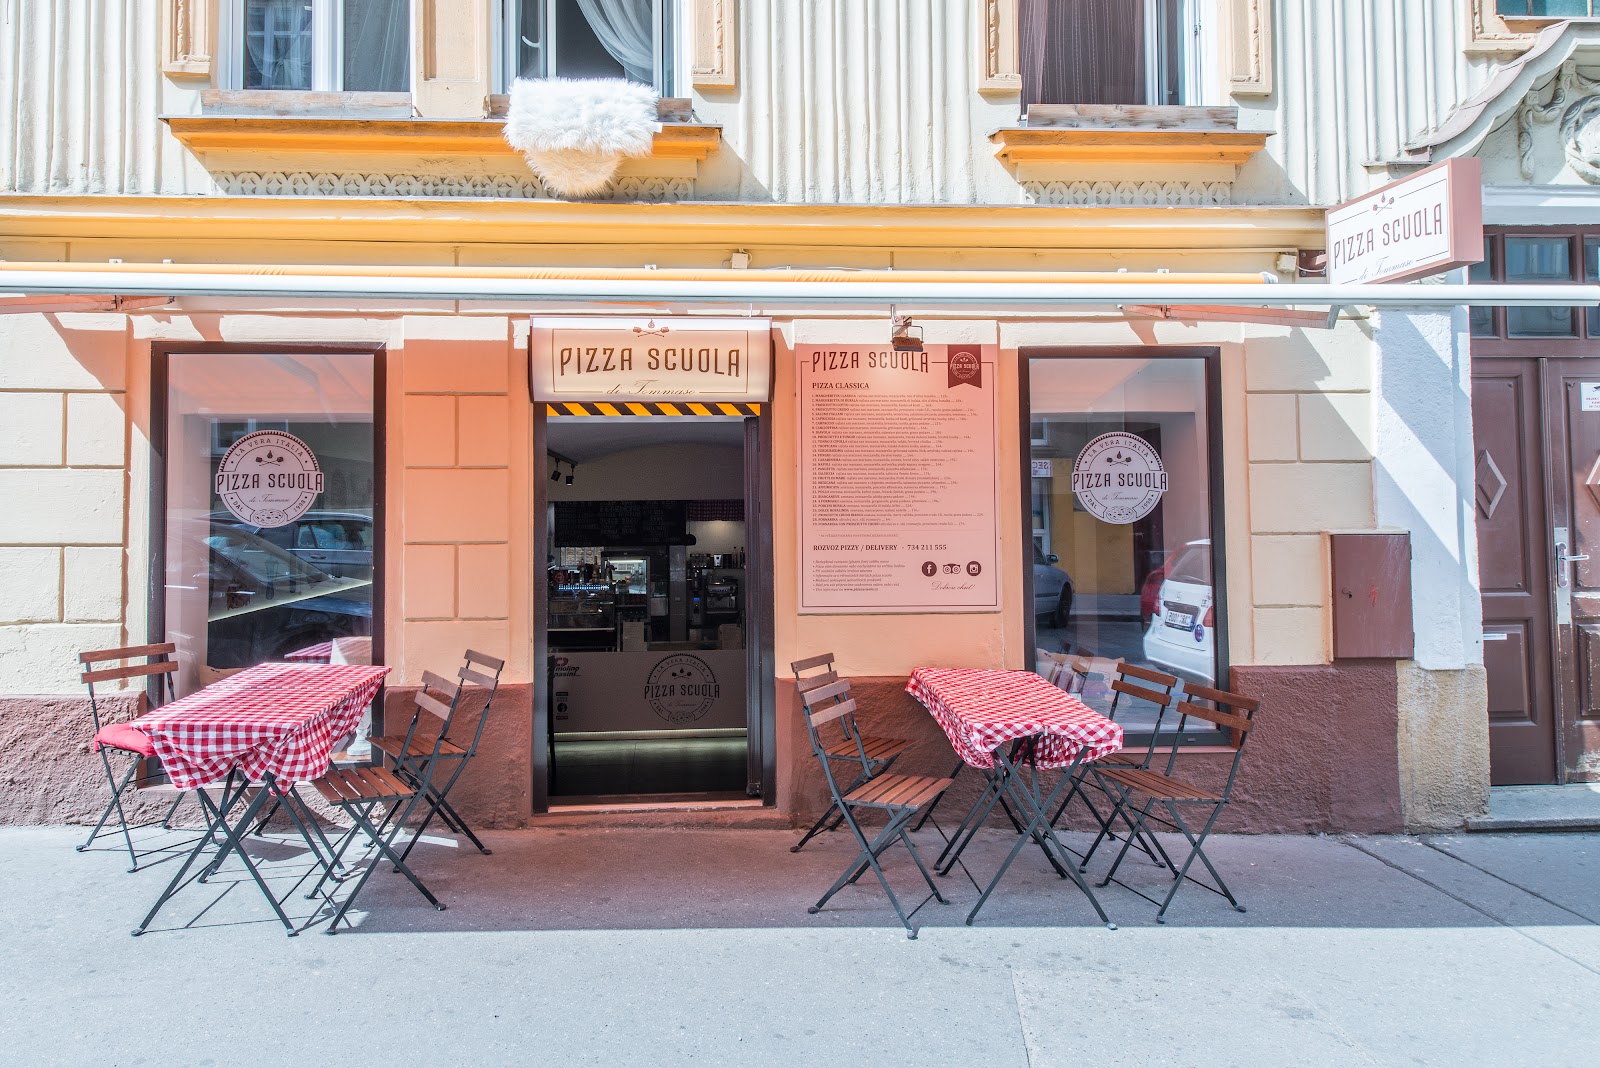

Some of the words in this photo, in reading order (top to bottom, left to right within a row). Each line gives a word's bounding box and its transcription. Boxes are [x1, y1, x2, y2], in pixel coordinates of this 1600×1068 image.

[1334, 228, 1374, 270] PIZZA
[1382, 202, 1443, 246] SCUOLA
[560, 347, 632, 376] PIZZA
[647, 347, 740, 378] SCUOLA
[812, 352, 860, 373] PIZZA
[868, 351, 929, 374] SCUOLA
[606, 384, 620, 395] di
[628, 379, 696, 395] Tommaso
[235, 448, 245, 457] LA
[248, 438, 271, 448] VERA
[276, 438, 304, 457] ITALIA
[1088, 449, 1097, 458] LA
[1099, 439, 1120, 449] VERA
[1124, 440, 1149, 458] ITALIA
[217, 473, 260, 493] PIZZA
[268, 473, 323, 492] SCUOLA
[1073, 473, 1111, 490] PIZZA
[1118, 473, 1167, 490] SCUOLA
[232, 500, 244, 513] DAL
[1087, 498, 1097, 510] DAL
[644, 684, 675, 699] PIZZA
[680, 684, 720, 698] SCUOLA
